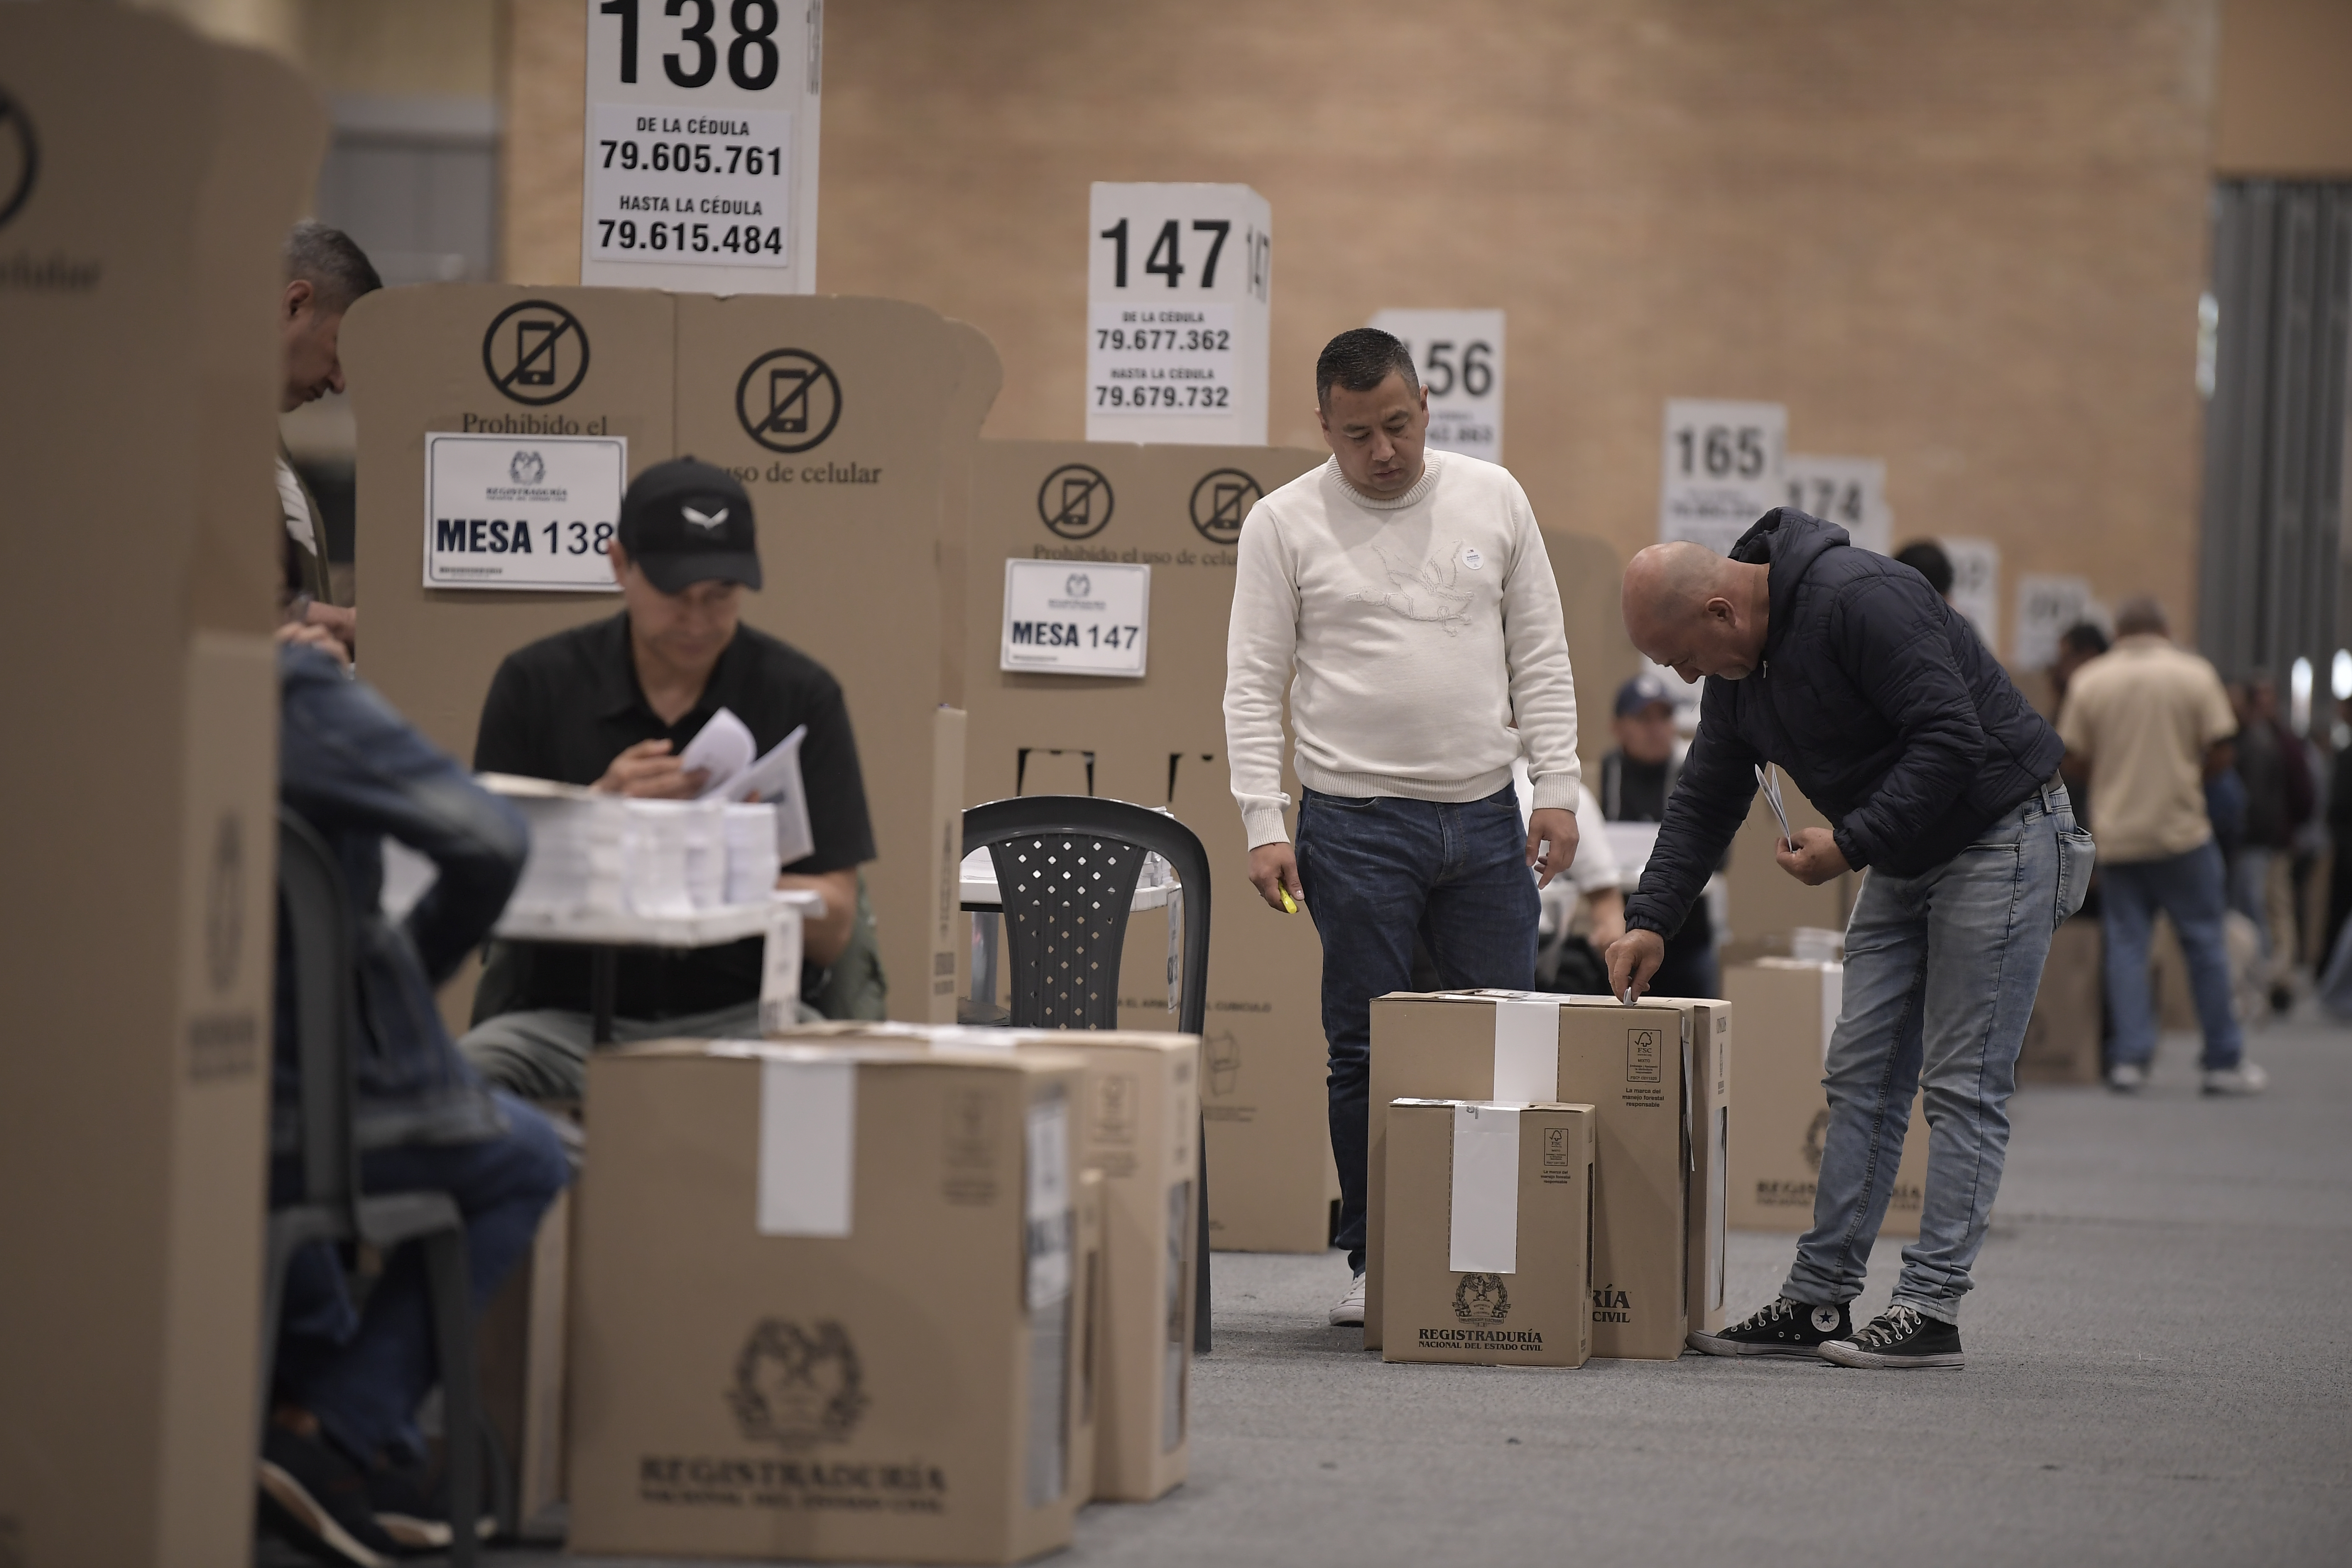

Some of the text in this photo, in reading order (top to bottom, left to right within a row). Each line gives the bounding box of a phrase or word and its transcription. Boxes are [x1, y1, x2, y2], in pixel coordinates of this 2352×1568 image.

[600, 0, 779, 90] 138
[637, 115, 750, 136] DE LA CÉDULA
[599, 140, 781, 176] 79.605.761
[620, 195, 762, 216] HASTA LA CÉDULA
[598, 219, 783, 255] 79.615.484
[1100, 217, 1231, 288] 147
[1097, 329, 1230, 351] 79.677.362
[1404, 340, 1493, 397] 56
[1095, 385, 1230, 408] 79.679.732
[463, 412, 607, 436] Prohibido el
[1676, 425, 1765, 480] 165
[766, 461, 794, 483] de
[801, 462, 882, 484] celular
[437, 519, 614, 555] MESA 138
[1202, 550, 1238, 565] celu
[1013, 621, 1138, 650] MESA 147
[1592, 1311, 1631, 1323] CIVIL
[1418, 1328, 1544, 1343] REGISTRADURÍA
